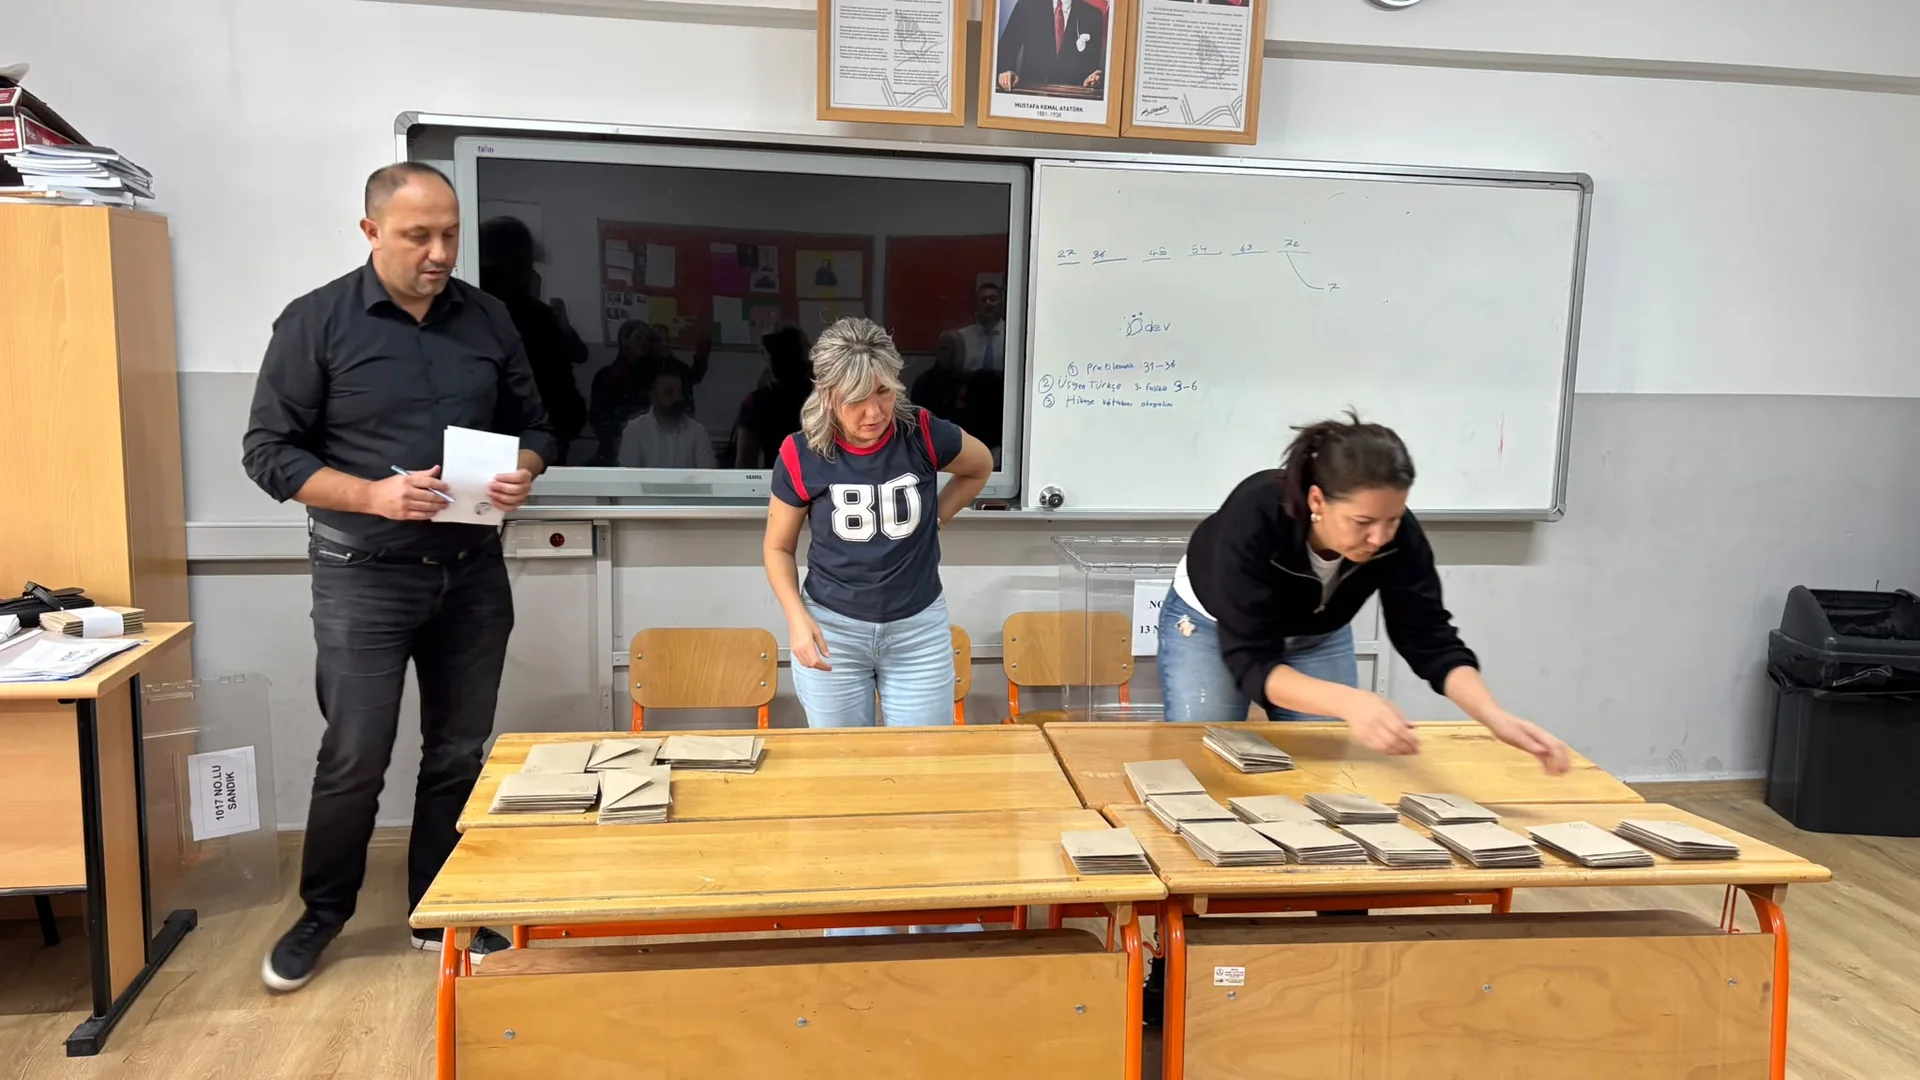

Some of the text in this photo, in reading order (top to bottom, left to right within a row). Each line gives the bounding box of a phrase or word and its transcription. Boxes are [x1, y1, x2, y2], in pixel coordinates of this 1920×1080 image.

[1014, 102, 1039, 110] MUSTAFA
[1059, 105, 1084, 113] ATATÜRK
[1036, 110, 1062, 118] 1881-1938
[1057, 249, 1077, 258] 27
[1092, 250, 1106, 260] 36
[1149, 246, 1168, 256] 45
[1191, 244, 1207, 254] 54
[1126, 312, 1171, 337] Ödev
[1088, 380, 1122, 392] Türkçe
[829, 472, 922, 542] 80
[1140, 625, 1151, 634] 13
[212, 765, 225, 821] 1017 NO.LU
[226, 771, 237, 810] SANDIK
